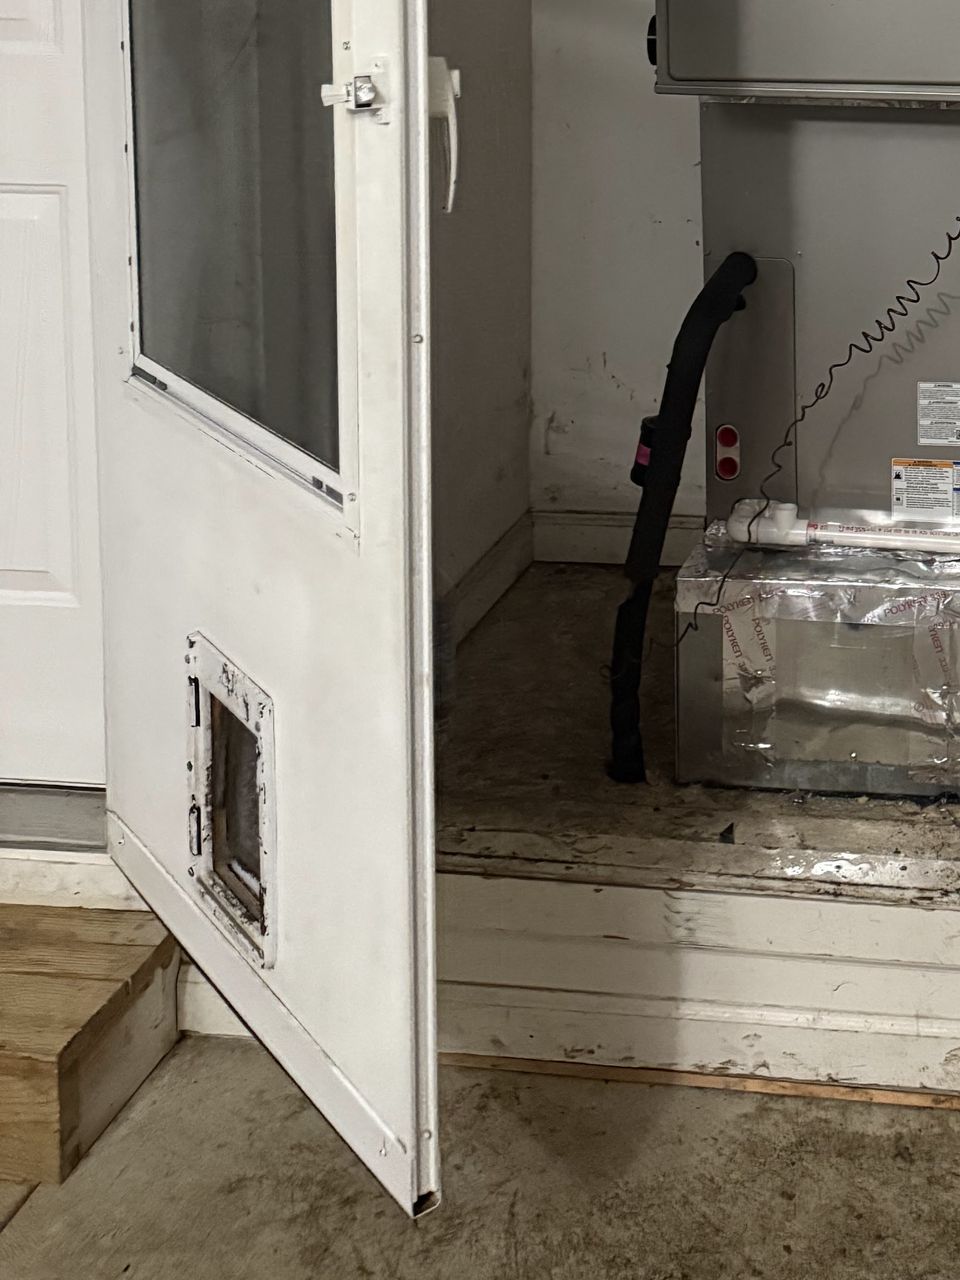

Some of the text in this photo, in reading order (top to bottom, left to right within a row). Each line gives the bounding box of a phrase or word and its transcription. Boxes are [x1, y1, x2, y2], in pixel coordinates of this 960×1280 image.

[712, 597, 755, 614] POLYKEN
[884, 597, 928, 617] POLYKEN
[723, 615, 743, 658] POLYKEN
[752, 617, 774, 662] POLYKEN
